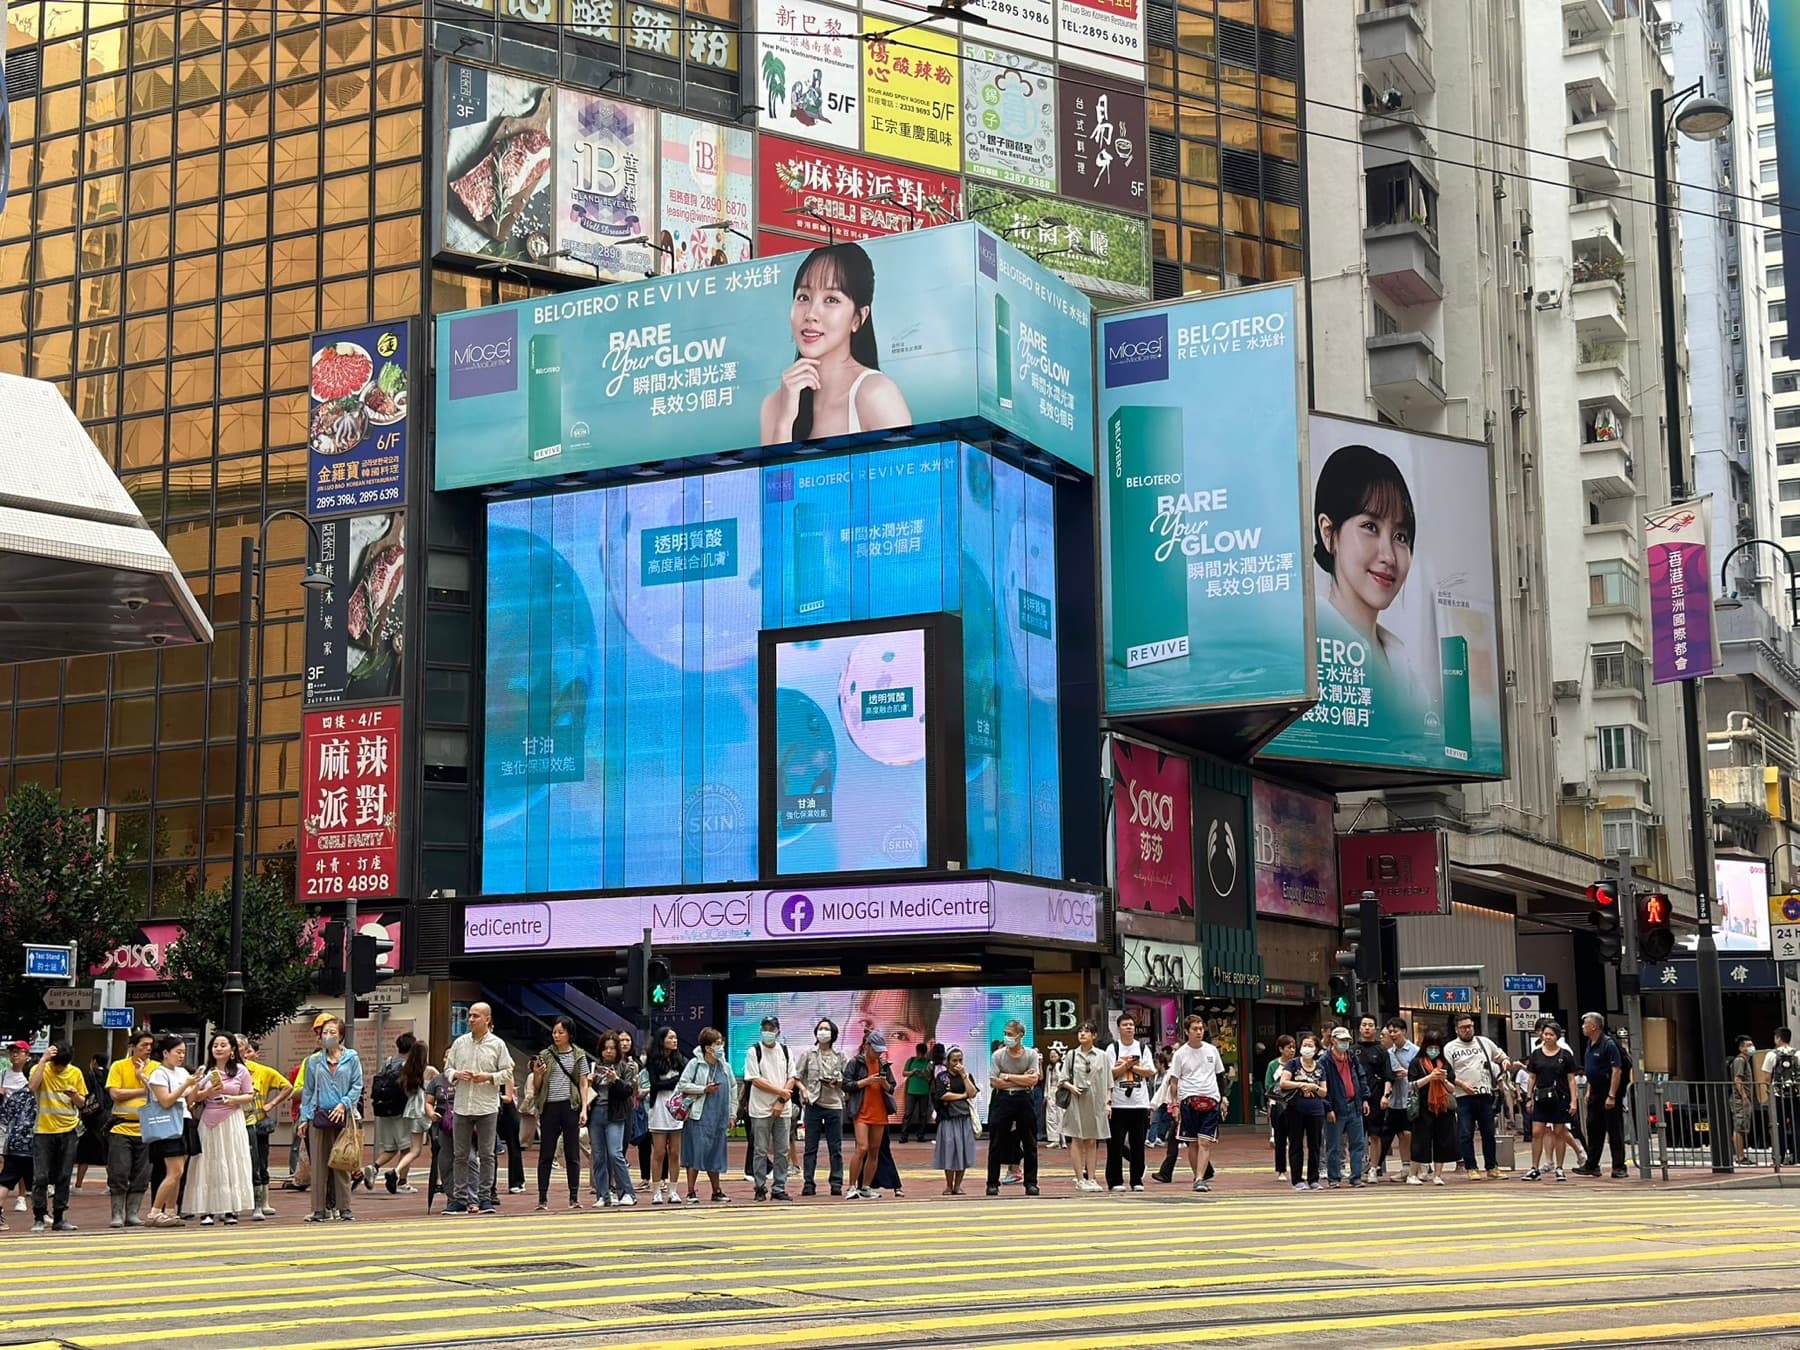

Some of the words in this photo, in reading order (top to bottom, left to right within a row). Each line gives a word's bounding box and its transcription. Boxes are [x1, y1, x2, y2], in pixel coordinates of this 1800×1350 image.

[776, 5, 842, 41] 新巴黎
[1022, 8, 1050, 25] 3986
[1062, 19, 1109, 41] TEL:2895
[1111, 33, 1138, 49] 6398
[762, 41, 775, 50] New
[775, 44, 791, 54] Paris
[792, 48, 824, 63] Vietnamese
[824, 55, 855, 70] Restaurant
[456, 104, 475, 118] 3F
[827, 92, 857, 114] 5/F
[932, 101, 955, 121] 5/F
[871, 115, 953, 147] 正宗重慶風味
[802, 159, 926, 213] 麻辣派對
[1130, 181, 1145, 198] 5F
[700, 195, 722, 213] 2890
[726, 200, 748, 218] 6870
[627, 276, 718, 308] REVIVE
[725, 264, 782, 292] 水光針
[1035, 284, 1068, 314] REVIVE
[609, 323, 672, 351] BARE
[1020, 322, 1048, 348] BARE
[1177, 339, 1241, 360] REVIVE
[1247, 332, 1286, 350] 水光針
[602, 347, 654, 397] Your
[654, 336, 727, 368] GLOW
[1040, 356, 1070, 387] GLOW
[650, 386, 734, 417] 長效9個月
[377, 432, 401, 450] 6/F
[1114, 420, 1122, 479] BELOTERO
[318, 460, 360, 484] 金羅寶
[859, 462, 915, 481] REVIVE
[1126, 474, 1181, 488] BELOTERO
[316, 495, 335, 509] 2895
[360, 490, 378, 503] 2895
[380, 487, 399, 501] 6398
[1157, 488, 1228, 514] BARE
[654, 528, 723, 555] 透明質酸
[1150, 511, 1209, 562] Your
[1181, 527, 1262, 556] GLOW
[1187, 553, 1294, 580] 瞬間水潤光澤
[1205, 573, 1290, 599] 長效9個月
[1130, 639, 1187, 662] REVIVE
[308, 666, 325, 680] 3F
[1326, 665, 1366, 686] 水光針
[358, 712, 383, 727] 4/F
[318, 734, 389, 781] 麻辣
[522, 736, 554, 756] 甘油
[318, 784, 389, 829] 派對
[798, 798, 816, 810] 甘油
[689, 815, 734, 834] SKIN
[888, 840, 913, 850] SKIN
[307, 876, 343, 895] 2178
[347, 874, 389, 892] 4898
[821, 902, 885, 921] MIOGGI
[890, 897, 990, 919] MediCentre
[1776, 928, 1792, 939] 24
[35, 952, 45, 960] Taxi
[46, 953, 60, 961] Stand
[1222, 971, 1232, 983] THE
[1233, 972, 1246, 984] BODY
[1247, 974, 1260, 985] SHOP
[689, 1006, 705, 1020] 3F
[1525, 1012, 1537, 1020] hrs
